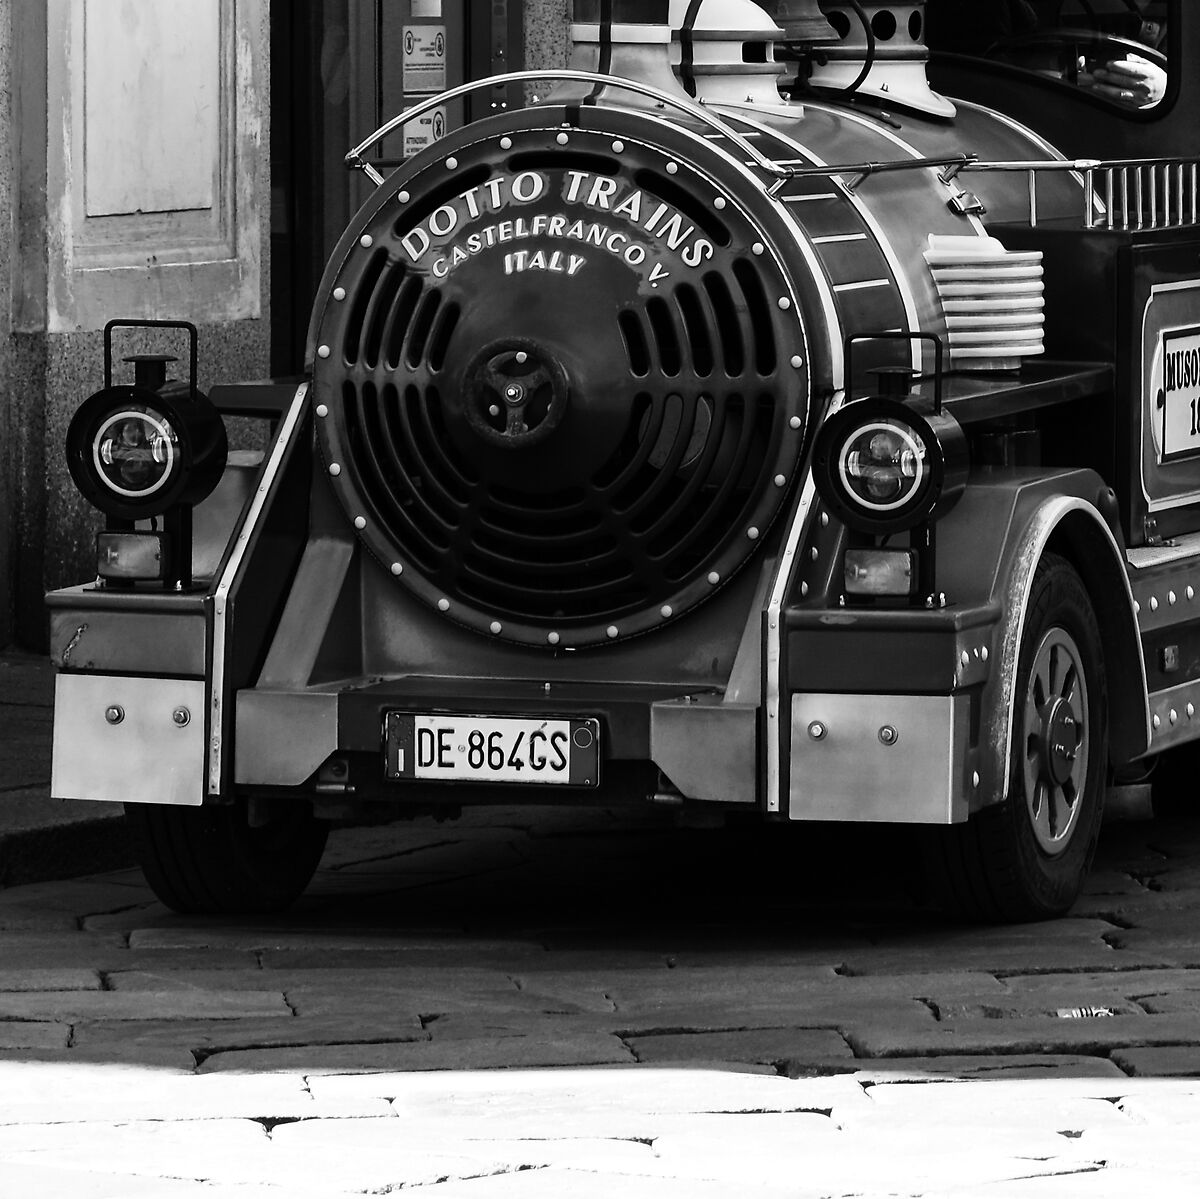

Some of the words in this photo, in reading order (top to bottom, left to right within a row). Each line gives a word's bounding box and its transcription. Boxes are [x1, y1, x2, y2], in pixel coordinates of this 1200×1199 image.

[401, 172, 544, 262] DOTTO
[566, 170, 714, 267] TRAINS
[432, 215, 646, 278] CASTELFRANCO
[503, 250, 587, 275] ITALY
[417, 728, 455, 768] DE
[467, 729, 568, 771] 864GS
